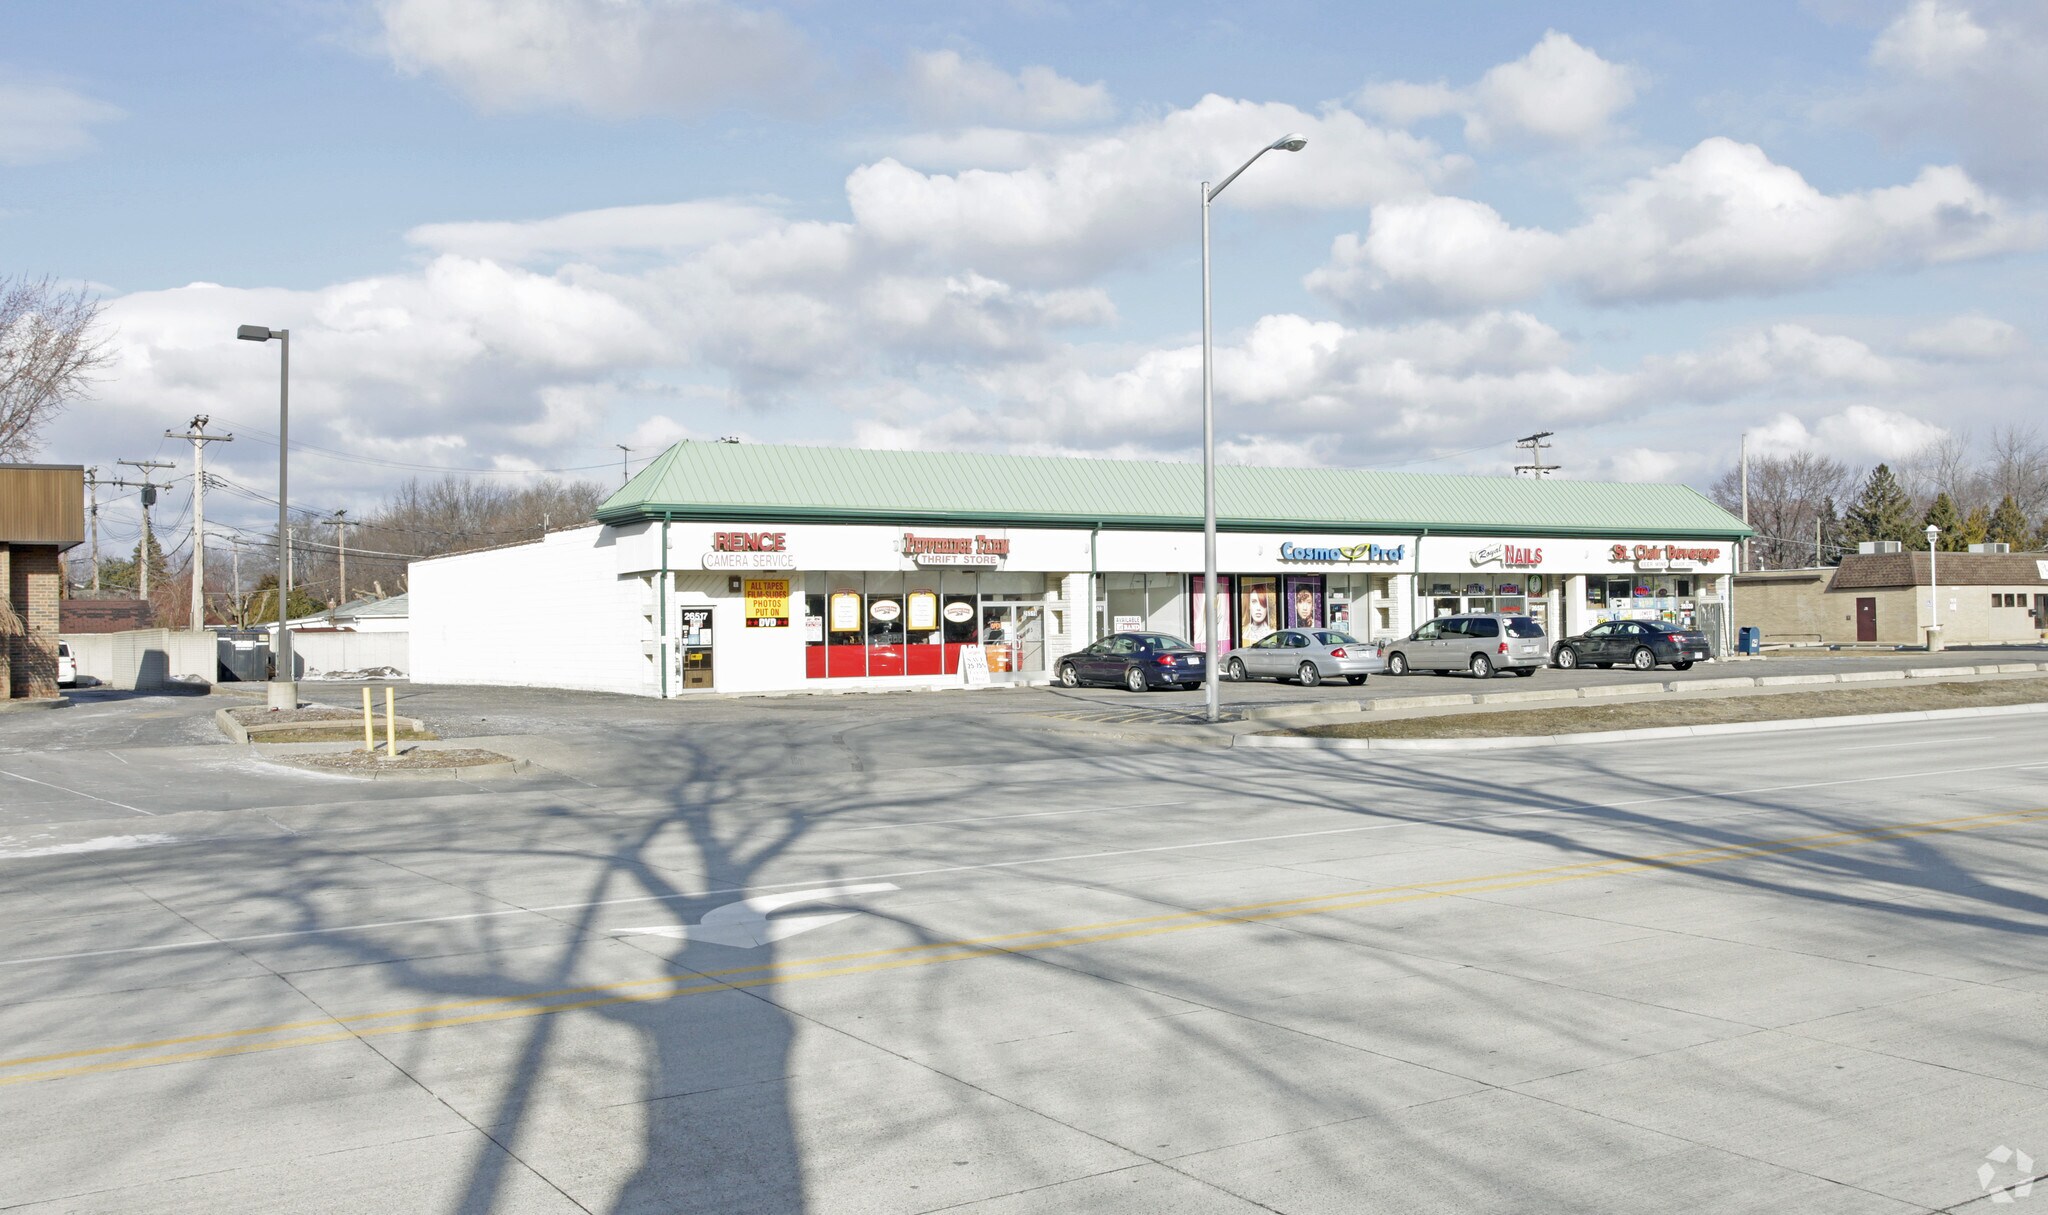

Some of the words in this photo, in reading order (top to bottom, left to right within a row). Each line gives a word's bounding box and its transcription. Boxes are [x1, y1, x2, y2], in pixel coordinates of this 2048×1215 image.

[713, 532, 787, 552] RENCE
[1280, 541, 1341, 560] Cosmo
[1369, 543, 1406, 560] Prof
[1478, 544, 1502, 559] Royal
[1504, 545, 1543, 564] NAILS
[1634, 544, 1662, 560] Clair
[1666, 544, 1720, 563] Beverage
[706, 554, 749, 567] CAMERA
[753, 554, 795, 567] SERVICE
[922, 555, 958, 564] THRIFT
[963, 555, 997, 564] STORE
[750, 582, 763, 591] ALL
[764, 582, 784, 591] TAPES
[747, 590, 787, 599] FILM-SLIDES
[753, 599, 782, 608] PHOTOS
[684, 612, 709, 621] 26517
[755, 608, 768, 616] PUT
[770, 608, 780, 616] ON
[758, 618, 777, 627] DVD
